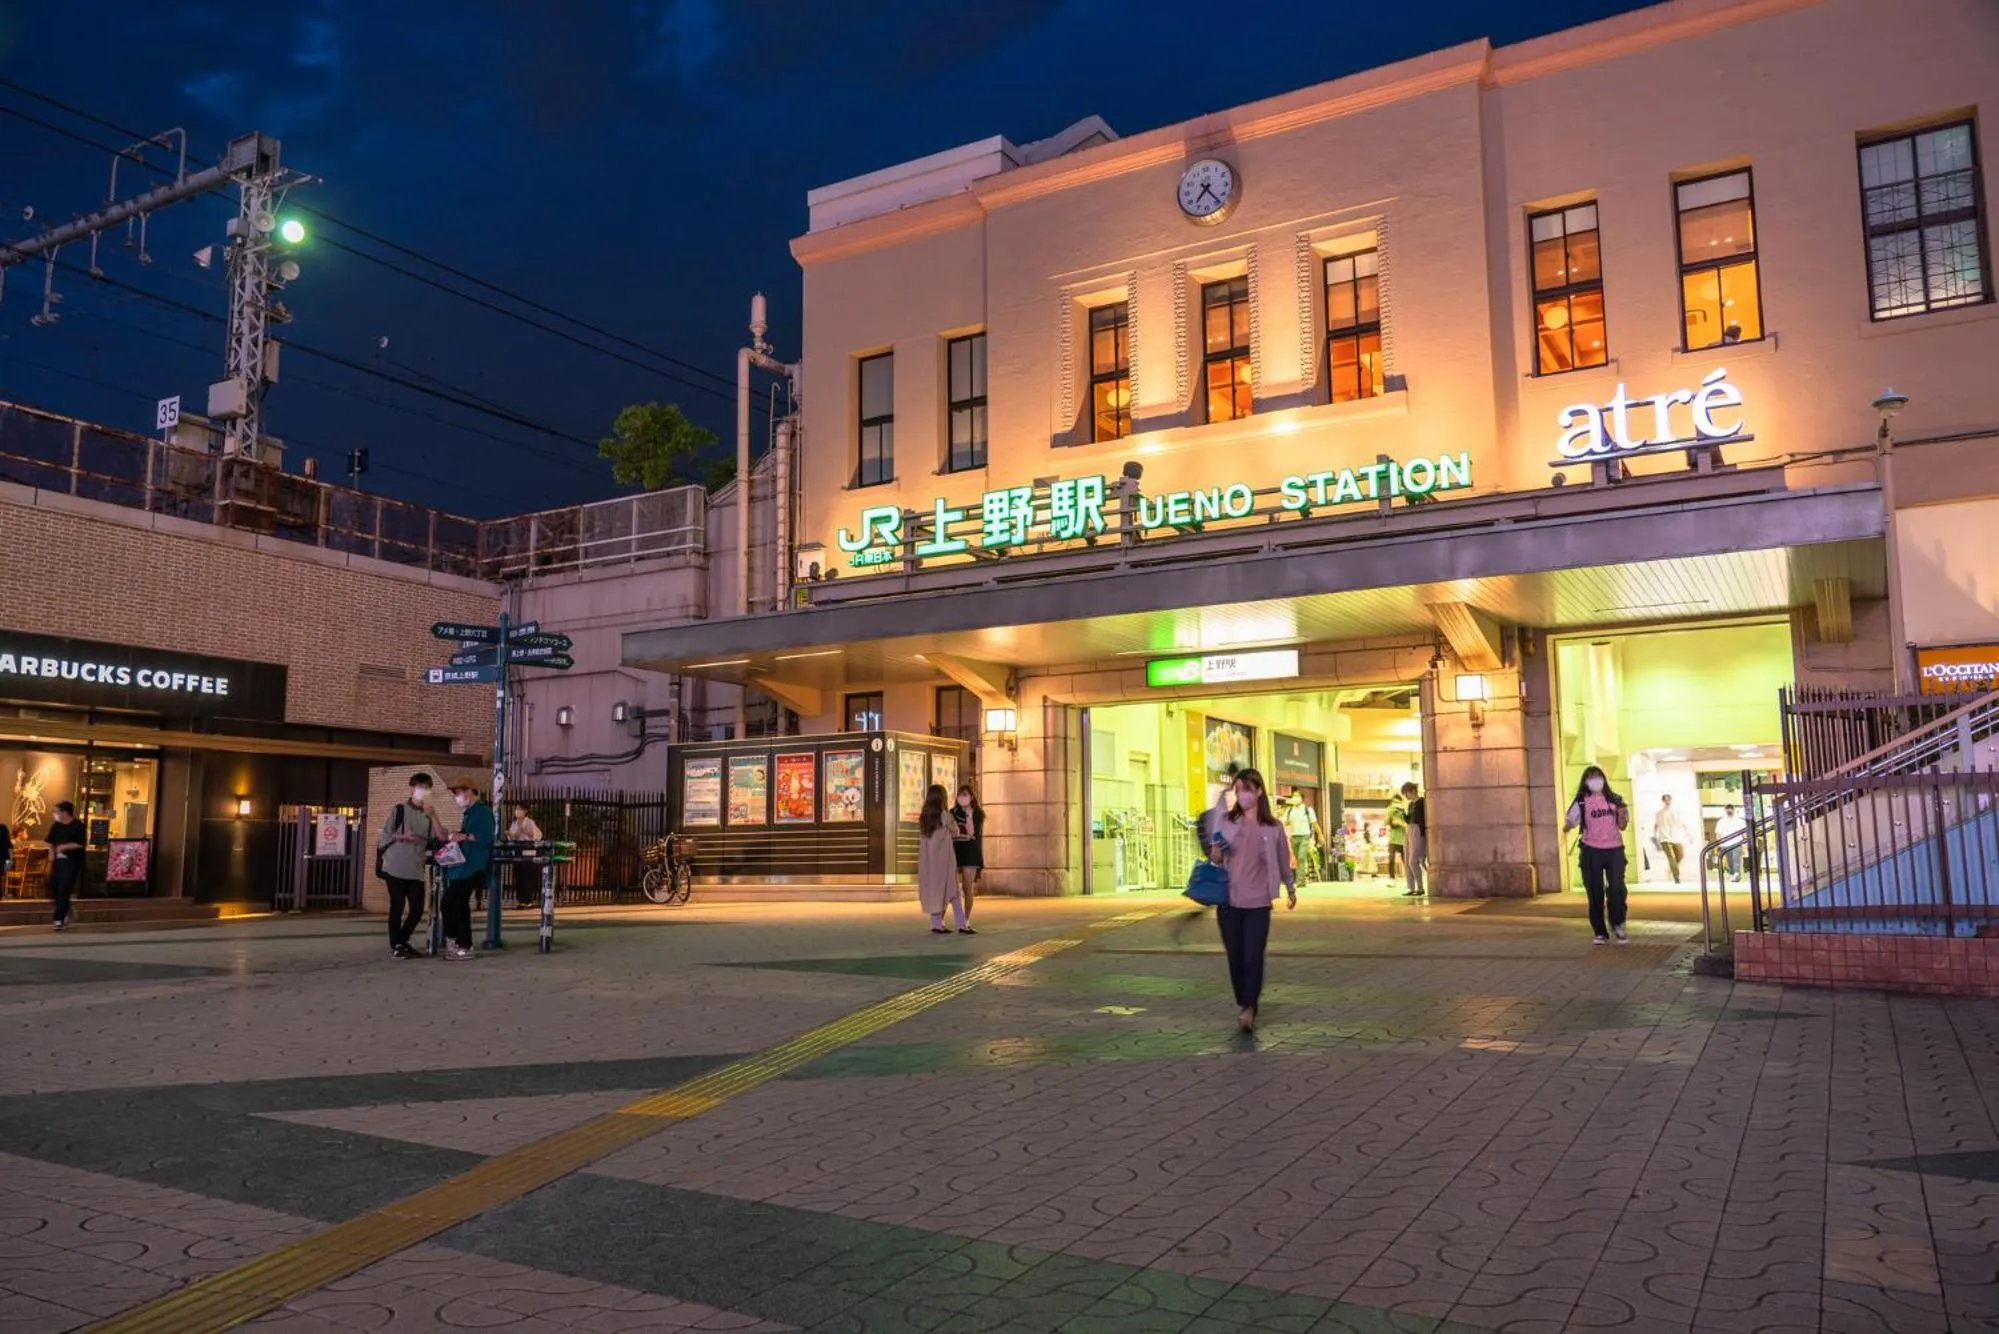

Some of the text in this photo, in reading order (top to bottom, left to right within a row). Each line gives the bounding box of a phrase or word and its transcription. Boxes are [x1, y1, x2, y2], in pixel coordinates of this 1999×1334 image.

[160, 401, 177, 424] 35
[1556, 368, 1744, 458] atré
[1139, 451, 1471, 529] UENO STATION
[837, 475, 1106, 557] JR 上野駅
[848, 551, 895, 567] JR東日本
[1205, 657, 1237, 671] 上野駅
[136, 669, 229, 695] COFFEE
